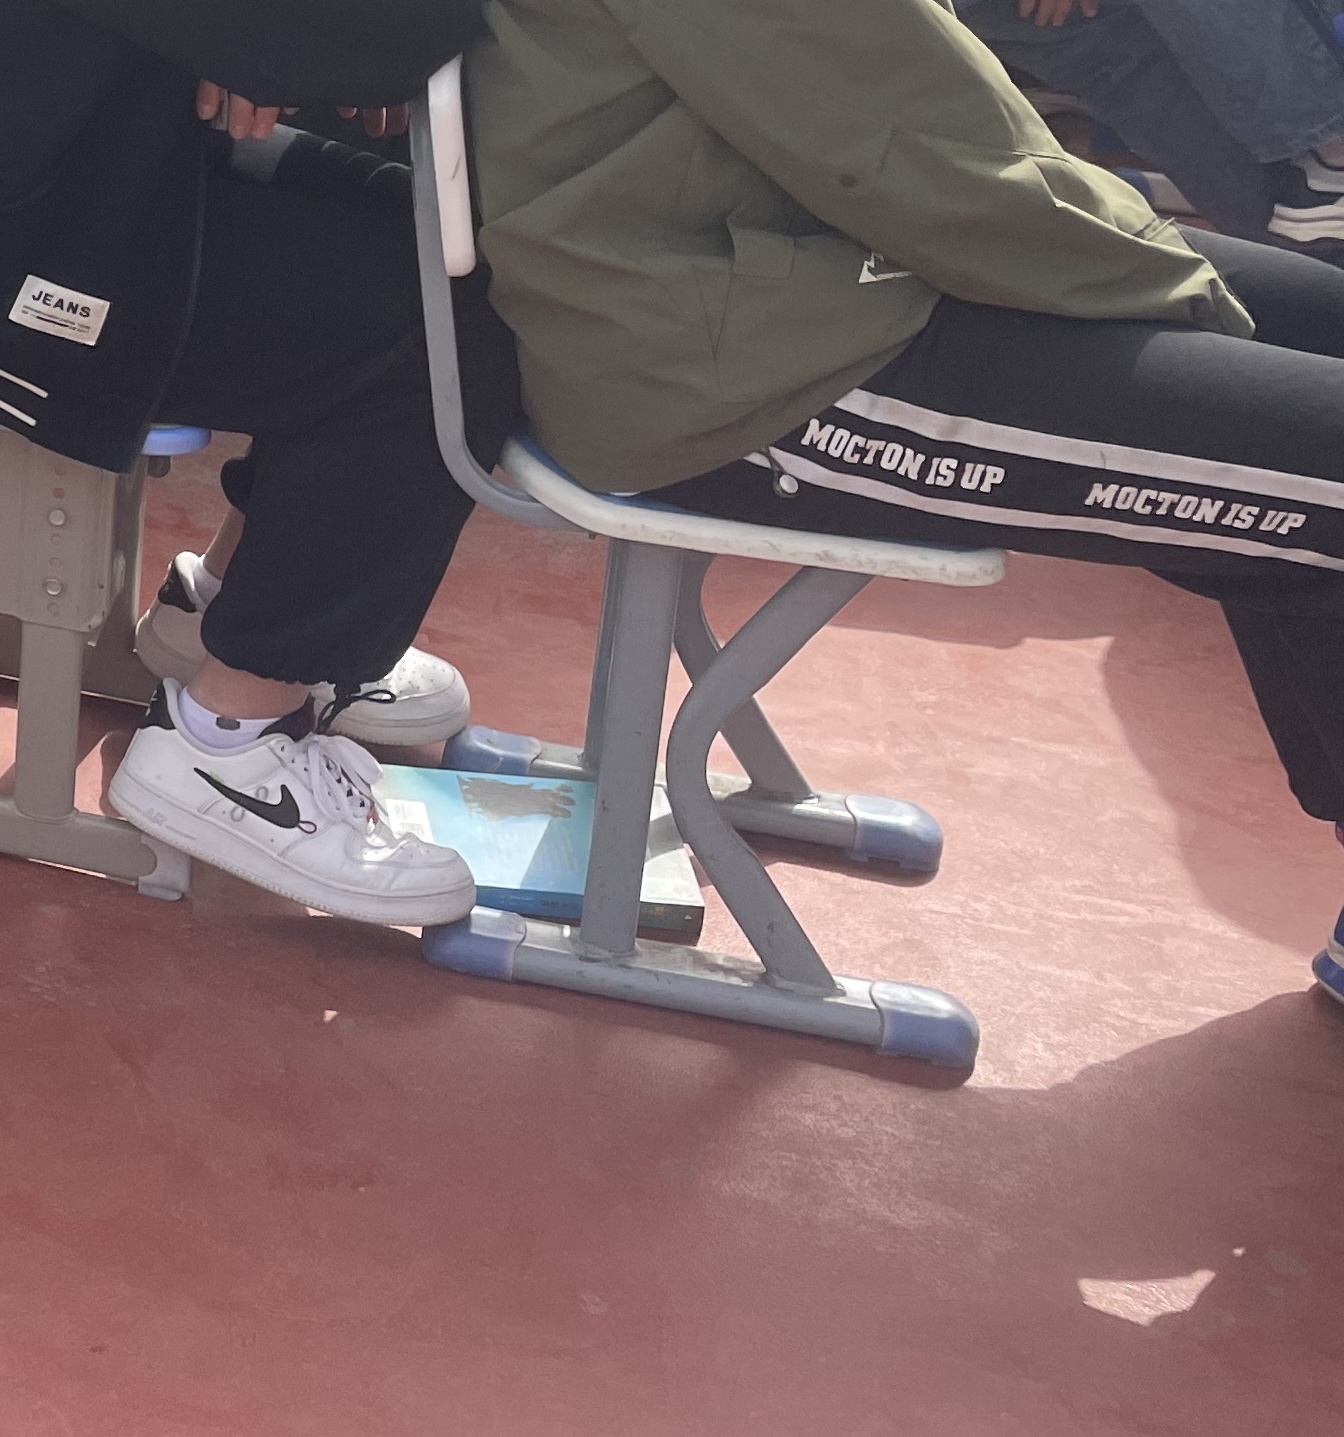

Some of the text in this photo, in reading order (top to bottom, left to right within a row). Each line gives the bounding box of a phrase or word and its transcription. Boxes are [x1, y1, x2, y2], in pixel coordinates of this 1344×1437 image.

[32, 290, 91, 318] JEANS
[800, 418, 1006, 494] MOCTON IS UP
[1084, 482, 1307, 535] MOCTON IS UP
